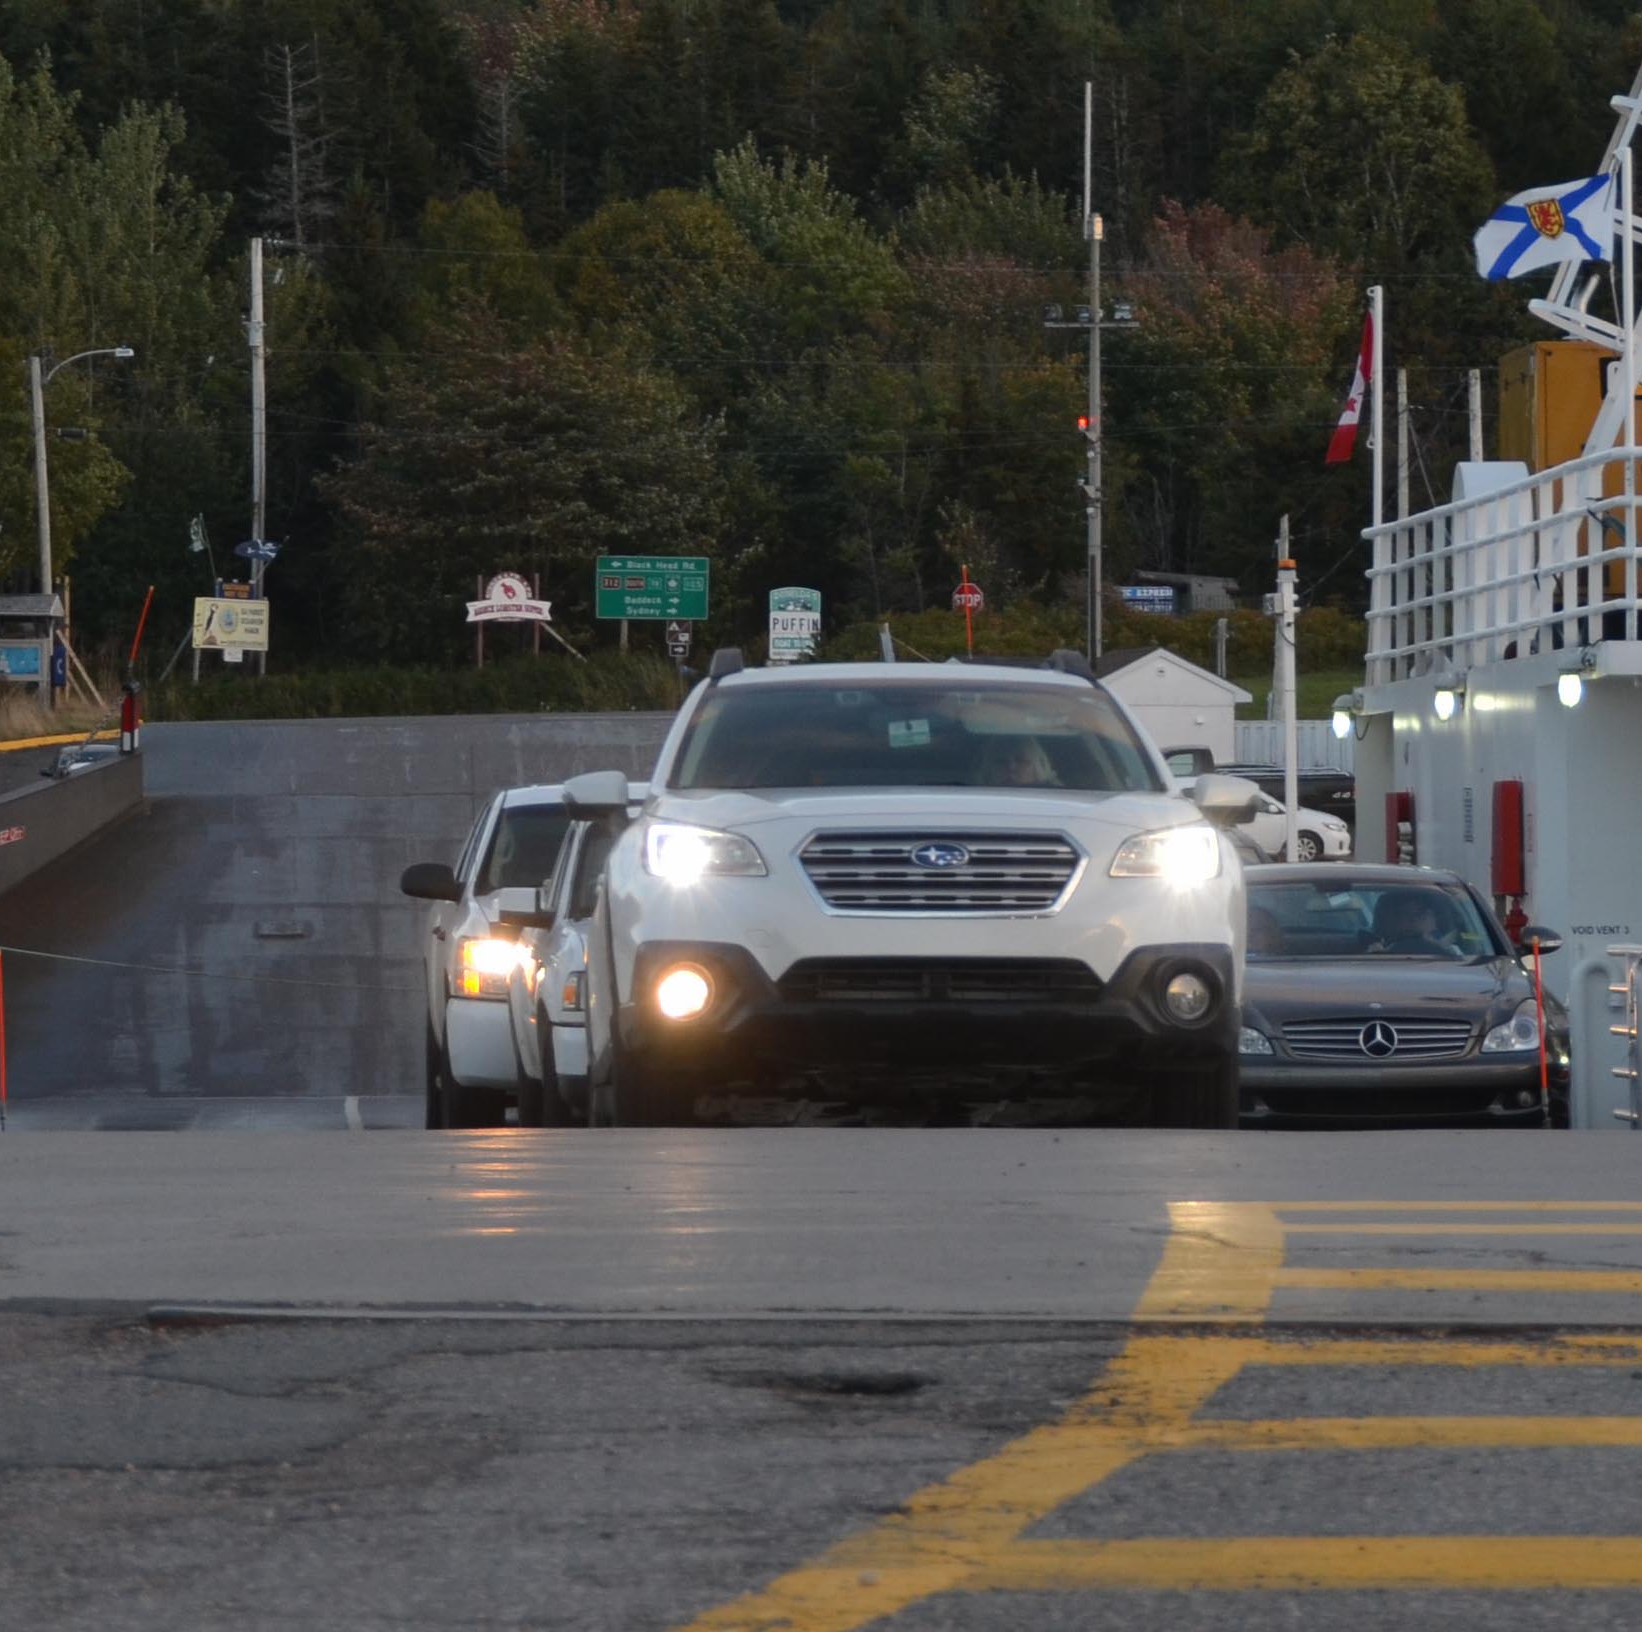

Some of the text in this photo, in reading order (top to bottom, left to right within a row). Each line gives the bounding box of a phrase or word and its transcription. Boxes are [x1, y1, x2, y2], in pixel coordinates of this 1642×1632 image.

[624, 595, 662, 605] Baddeck
[954, 594, 981, 607] STOP
[626, 606, 662, 617] Sydney
[772, 616, 820, 632] PUFFIN
[1571, 925, 1595, 935] VOID
[1596, 925, 1621, 935] VENT
